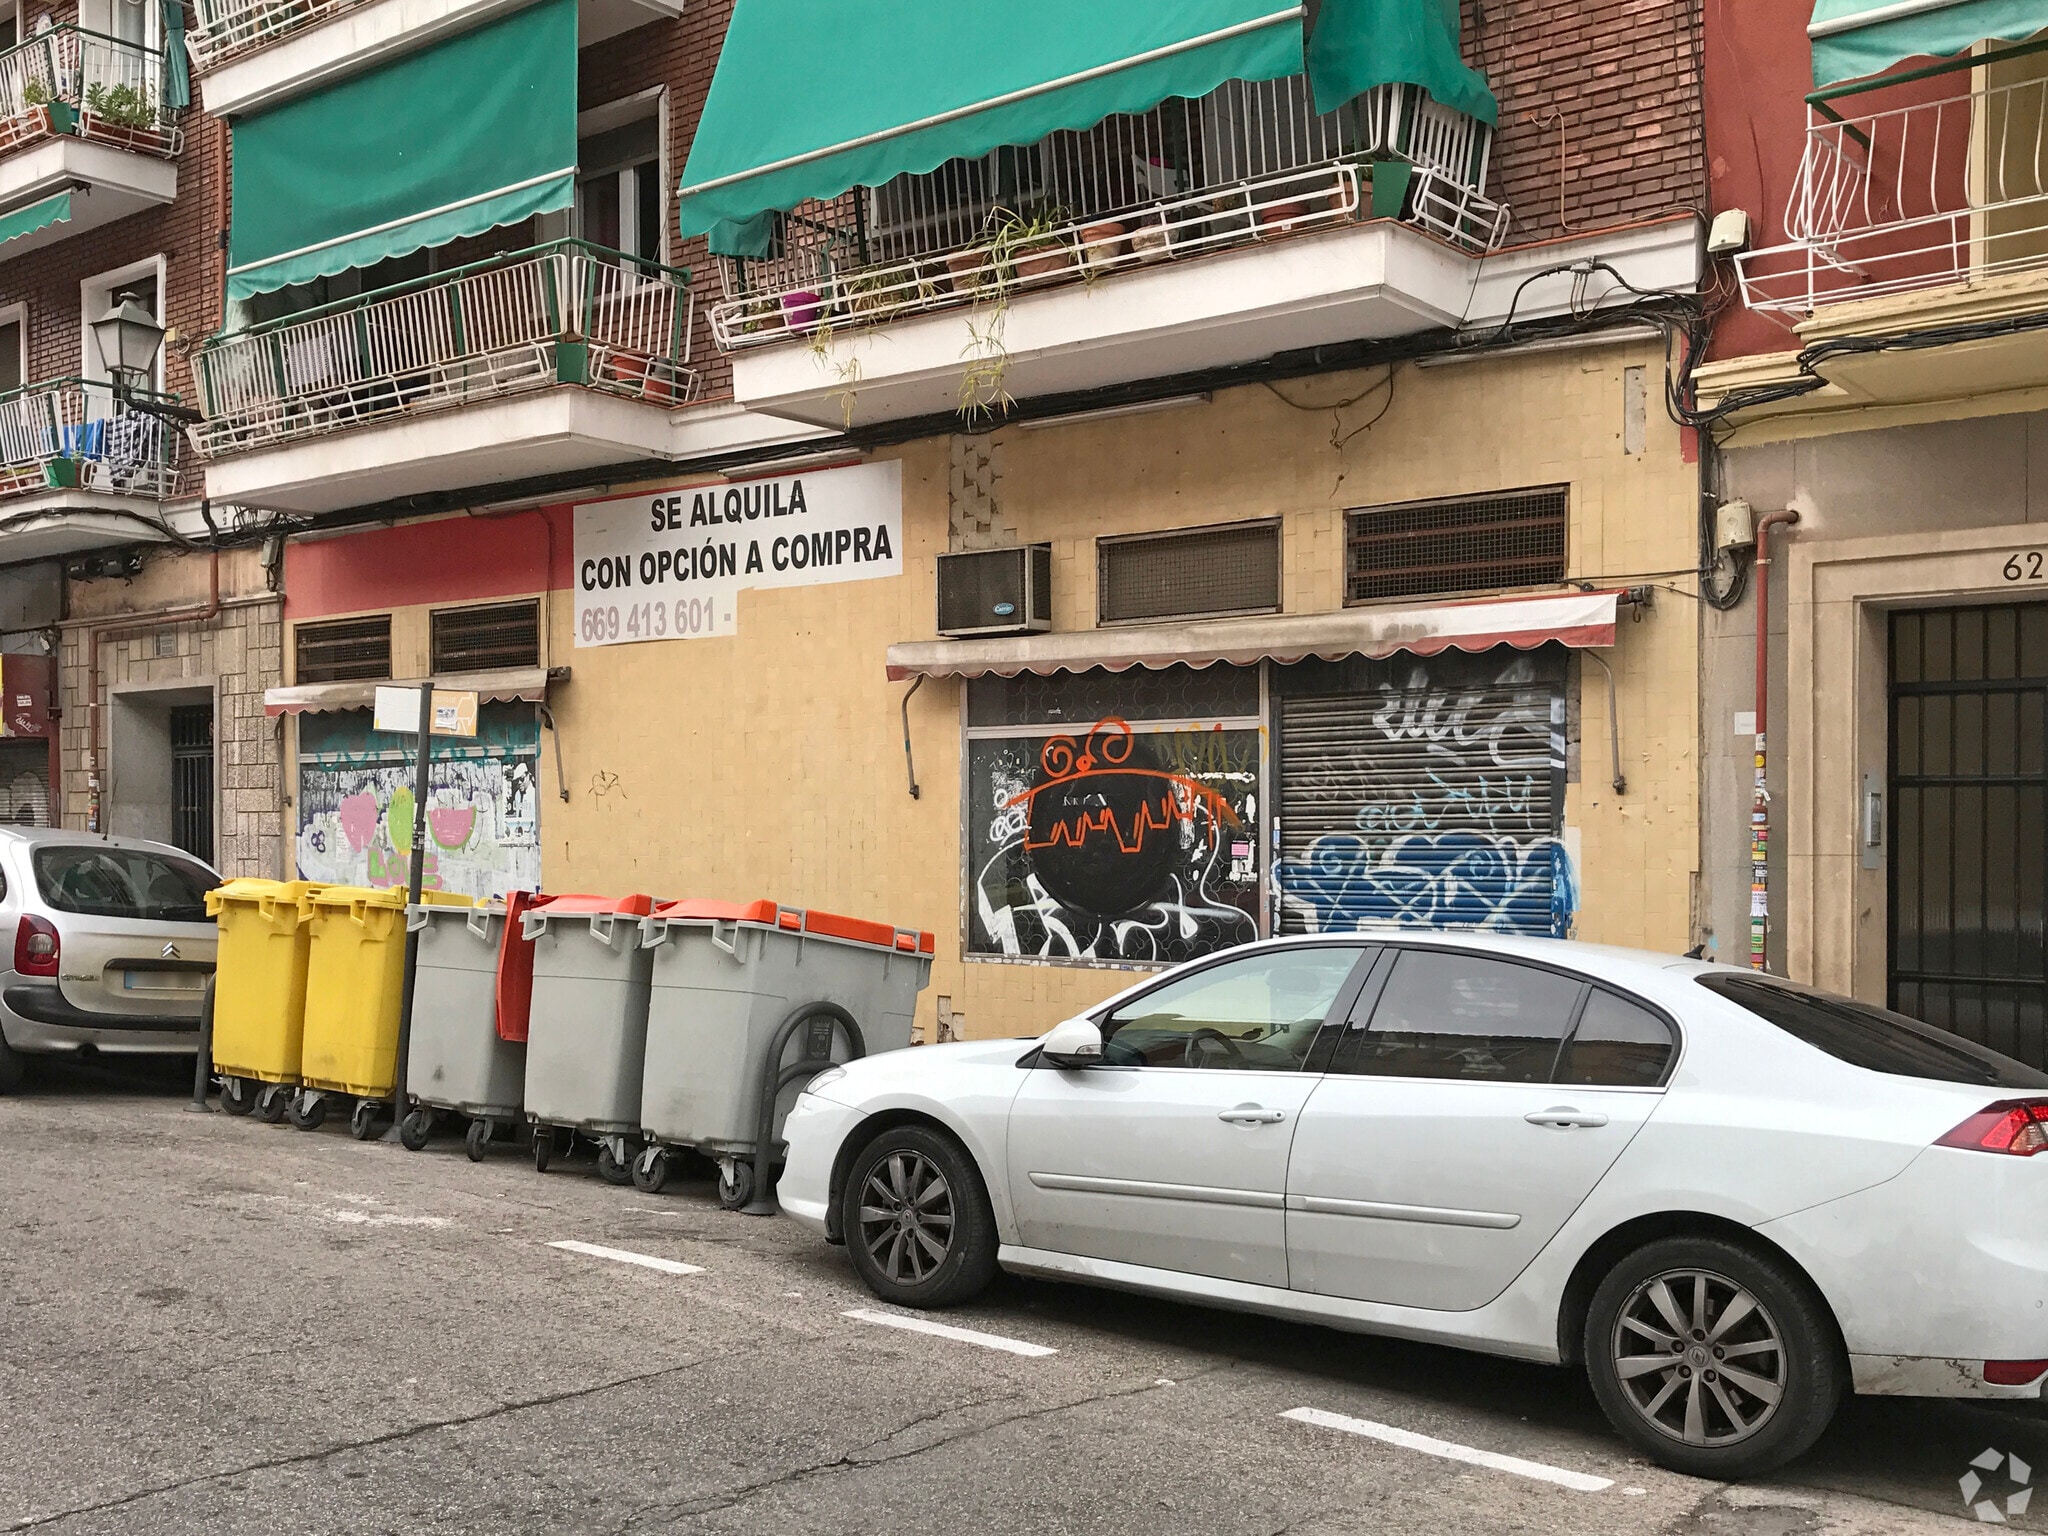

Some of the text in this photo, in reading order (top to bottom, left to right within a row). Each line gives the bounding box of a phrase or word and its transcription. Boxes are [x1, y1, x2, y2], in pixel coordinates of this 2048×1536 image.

[651, 480, 807, 532] SE ALQUILA
[581, 524, 893, 591] CON OPCIÓN A COMPRA
[2002, 551, 2043, 581] 62
[581, 605, 620, 642] 669
[627, 601, 667, 638] 413
[674, 596, 714, 635] 601
